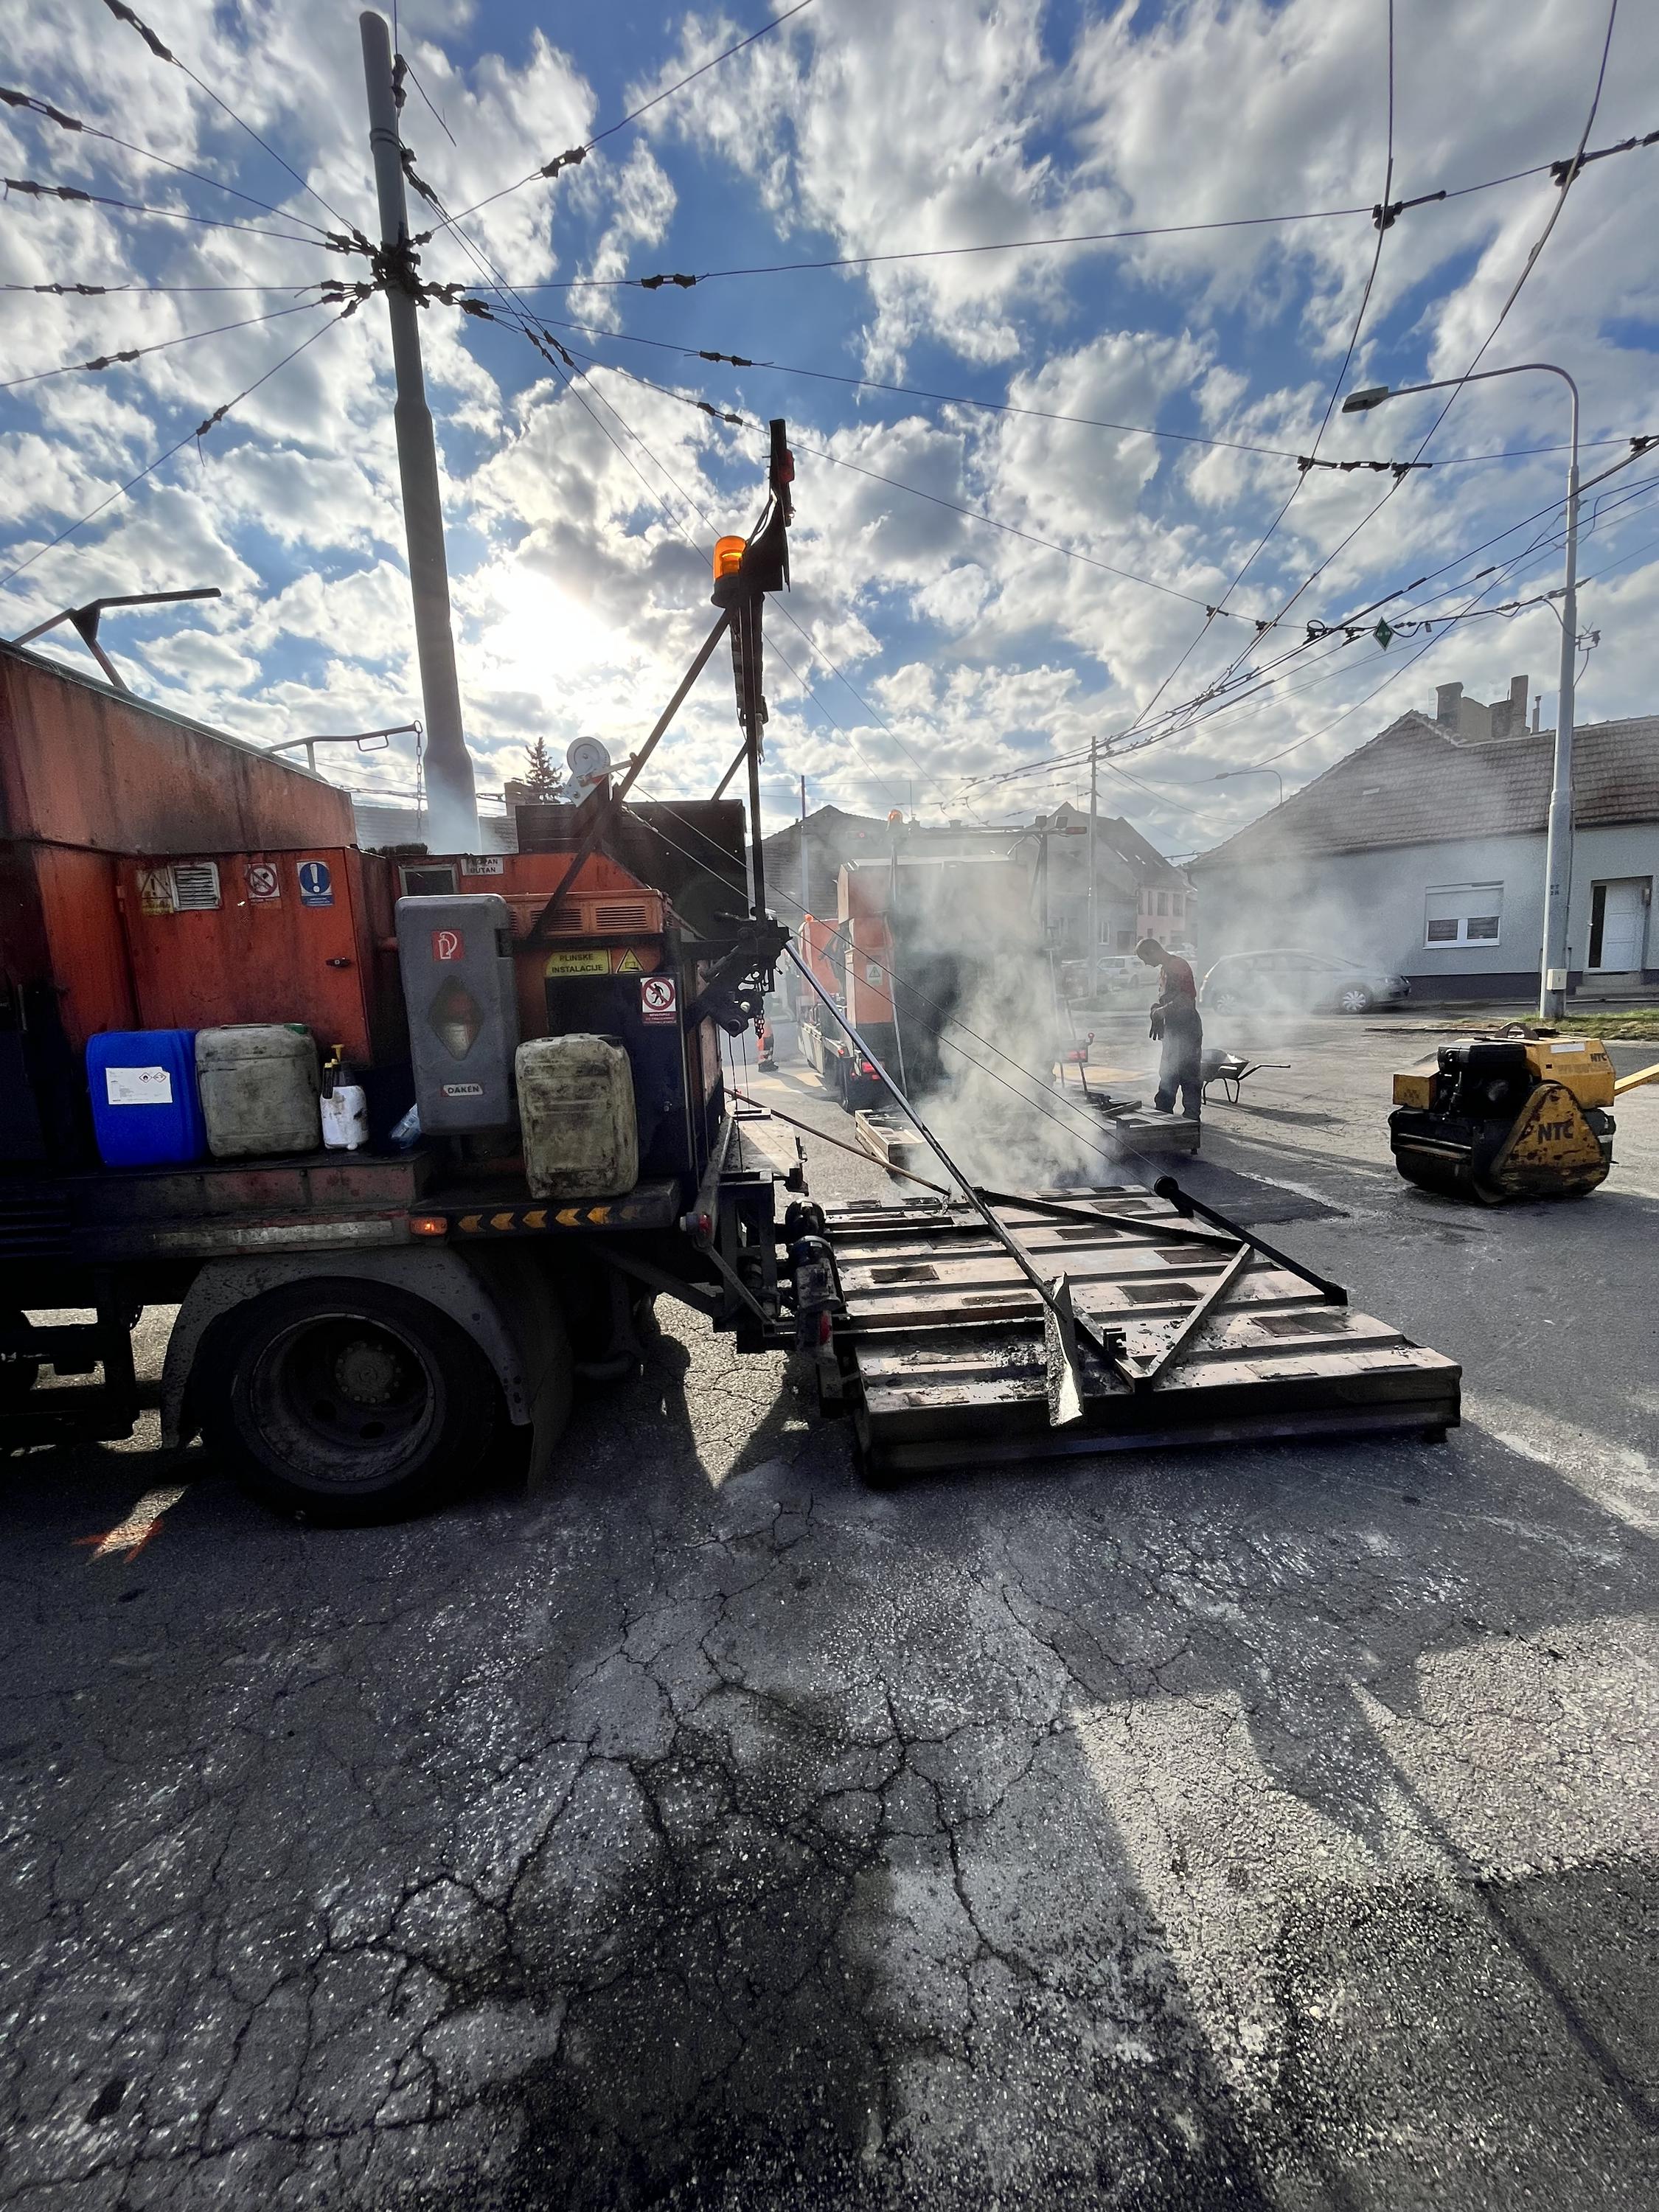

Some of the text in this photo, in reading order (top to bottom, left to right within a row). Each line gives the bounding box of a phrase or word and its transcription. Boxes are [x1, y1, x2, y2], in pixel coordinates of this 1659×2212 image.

[552, 964, 604, 973] INSTALACIJE
[1590, 1052, 1608, 1062] NTC
[1537, 1121, 1574, 1144] NTC
